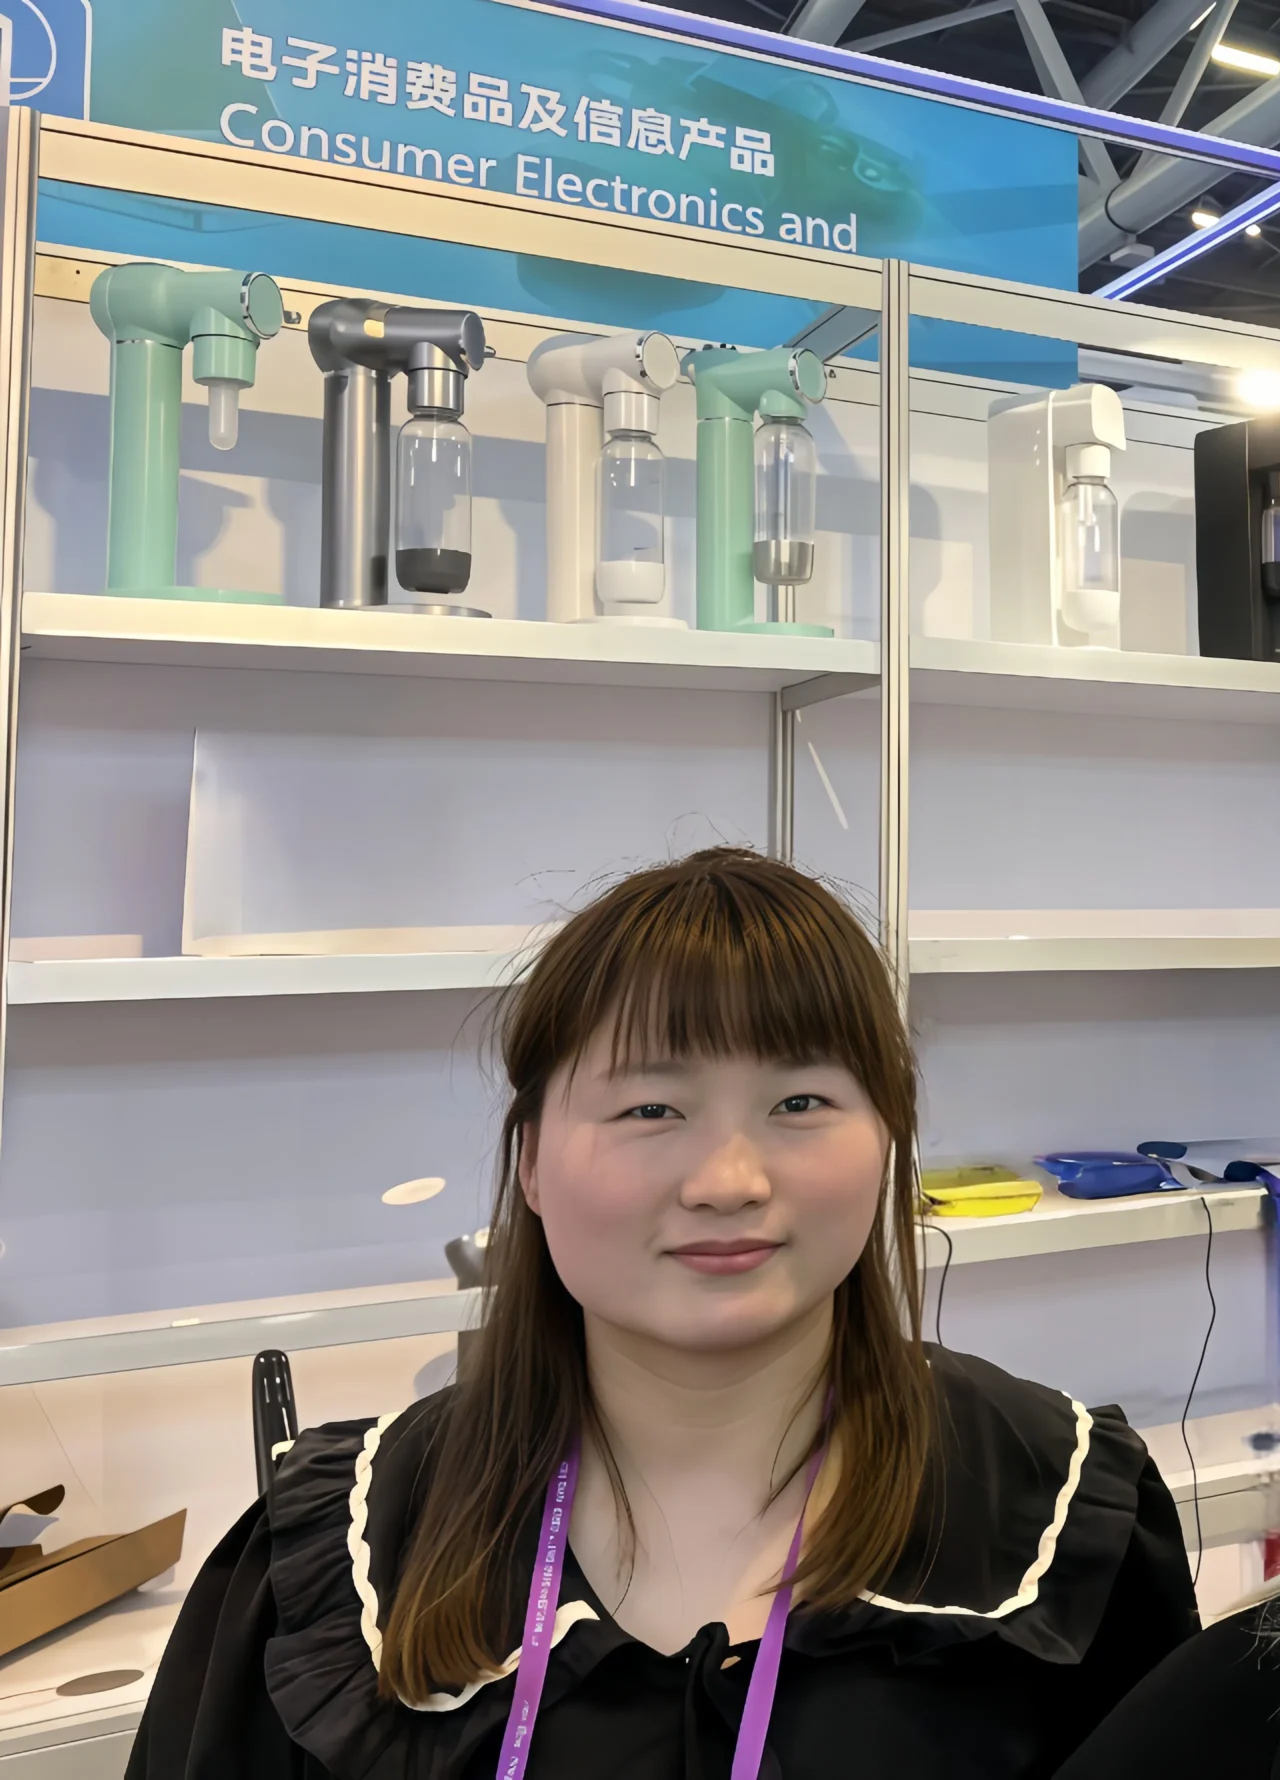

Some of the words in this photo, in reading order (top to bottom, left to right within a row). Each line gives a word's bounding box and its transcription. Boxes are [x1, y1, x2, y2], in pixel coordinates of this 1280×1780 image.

[221, 27, 775, 177] 电子消费品及信息产品
[220, 102, 497, 188] Consumer
[516, 153, 765, 236] Electronics
[778, 212, 857, 253] and
